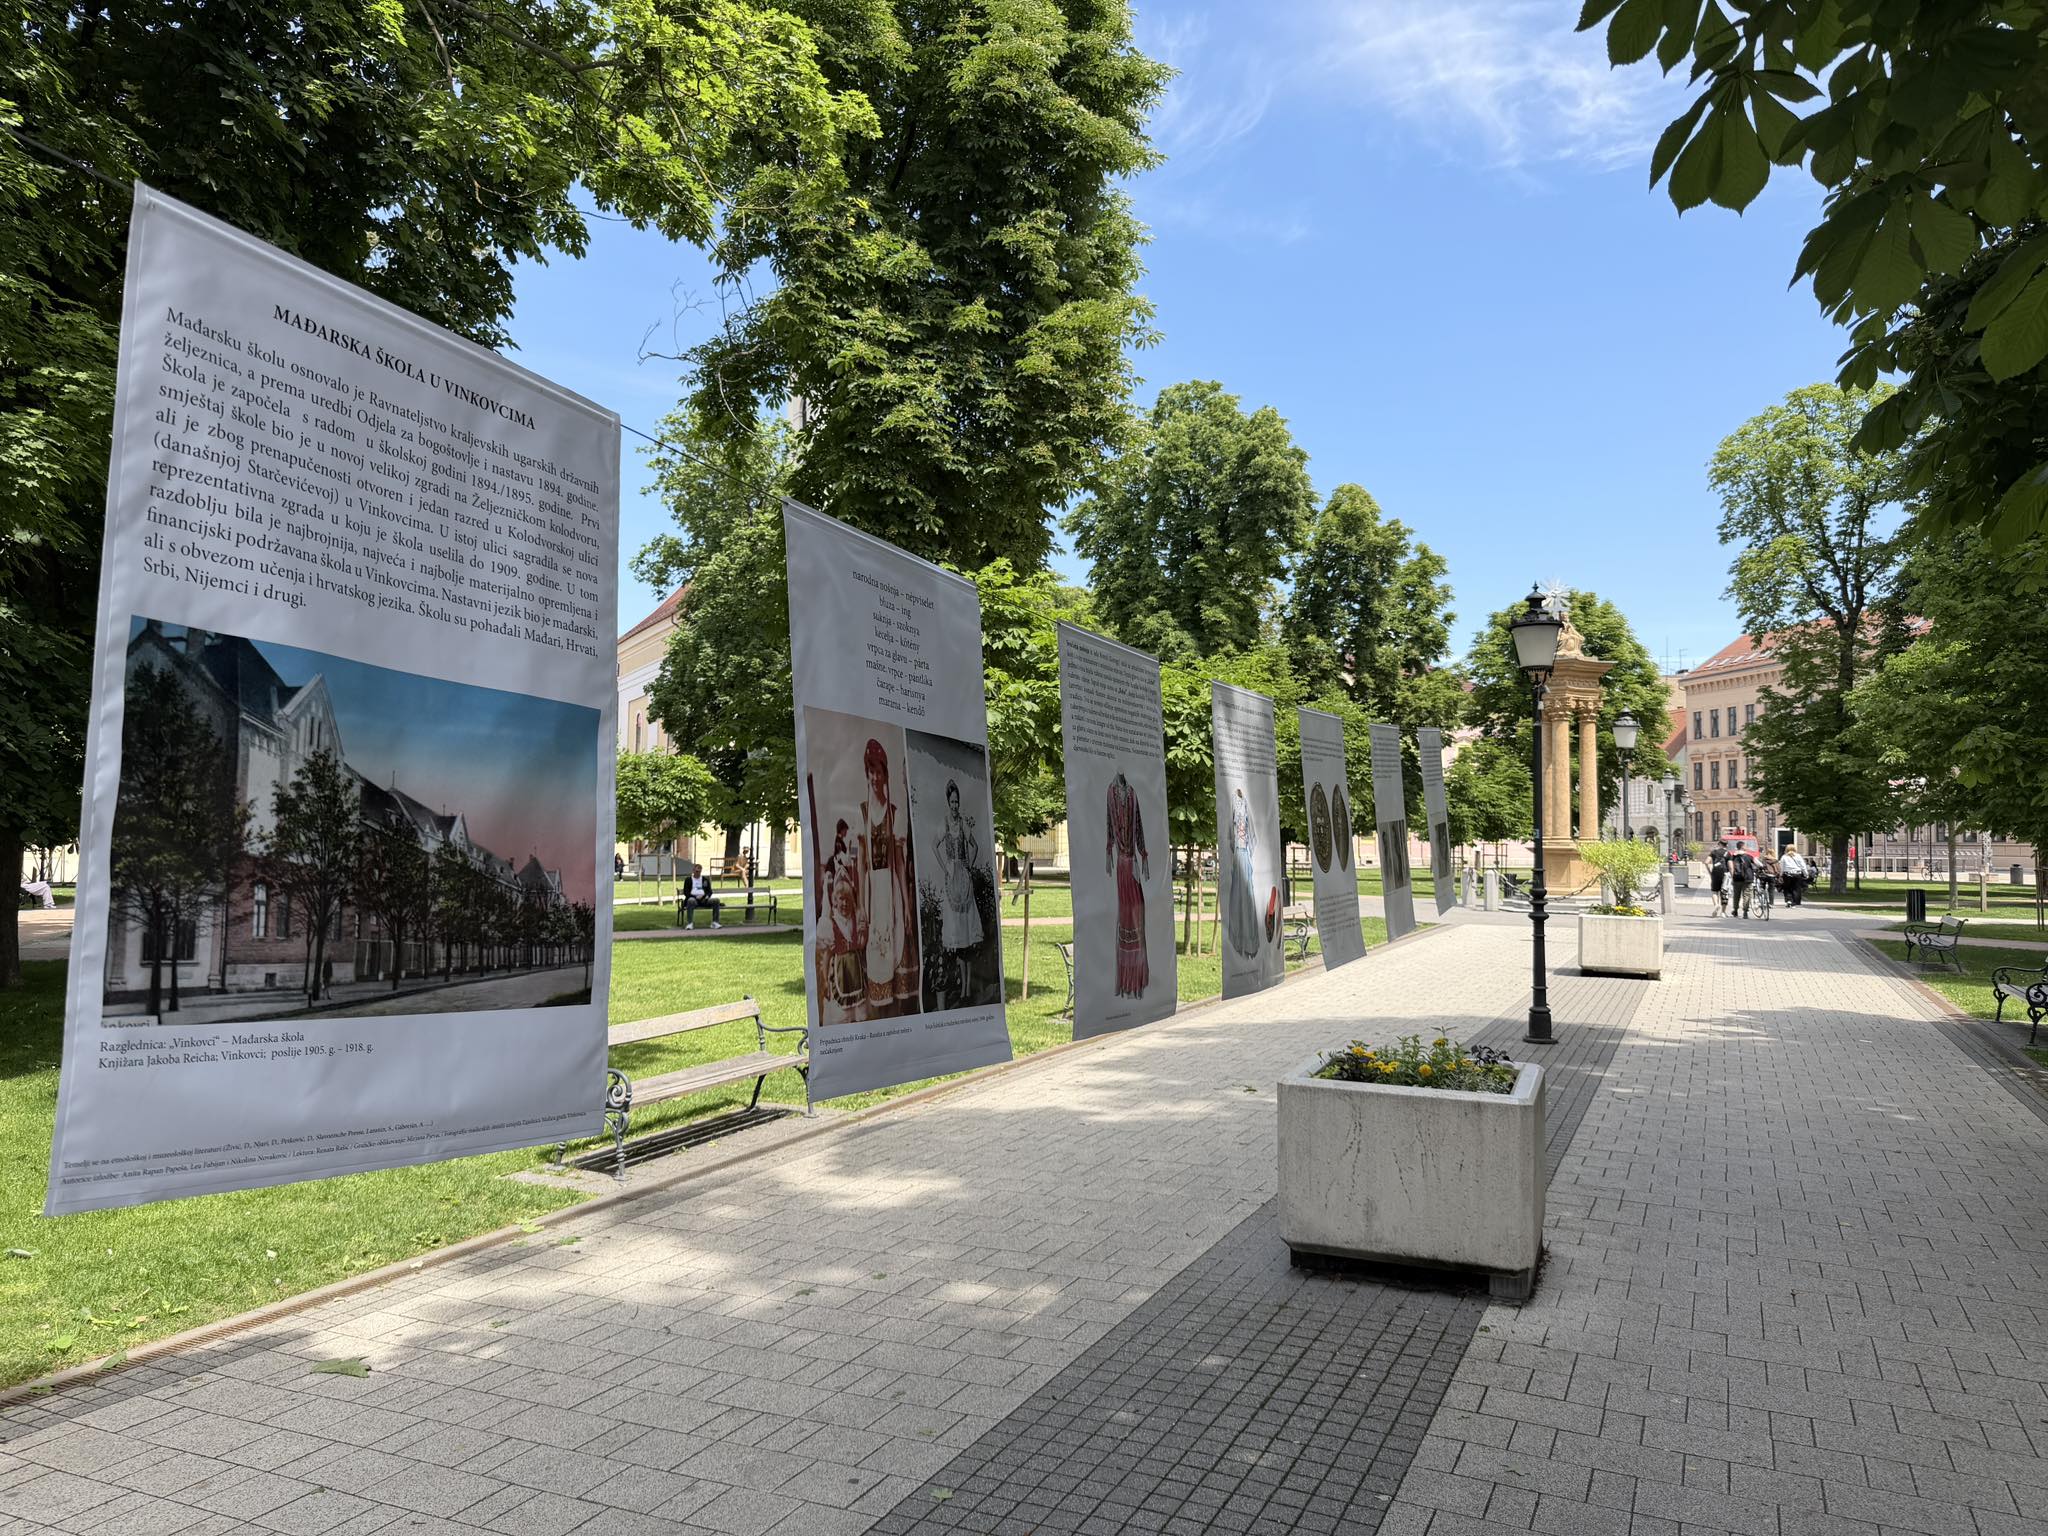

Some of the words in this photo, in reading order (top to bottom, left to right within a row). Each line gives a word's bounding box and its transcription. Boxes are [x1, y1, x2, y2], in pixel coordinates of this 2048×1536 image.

[163, 330, 242, 377] željeznica,
[247, 369, 256, 381] a
[260, 373, 306, 400] prema
[310, 392, 352, 419] uredbi
[356, 407, 397, 436] Odjela
[400, 428, 414, 443] za
[417, 430, 481, 470] bogoštovlje
[483, 457, 488, 472] i
[491, 463, 534, 487] nastavu
[538, 477, 564, 498] 1894.
[565, 491, 599, 513] godine.
[165, 306, 242, 352] Mađarsku
[246, 340, 285, 369] školu
[290, 362, 350, 395] osnovalo
[351, 384, 365, 402] je
[368, 391, 447, 434] Ravnateljstvo
[450, 423, 509, 459] kraljevskih
[512, 451, 557, 477] ugarskih
[559, 467, 599, 495] državnih
[272, 304, 372, 361] MAĐARSKA
[373, 345, 429, 384] ŠKOLA
[429, 372, 441, 389] U
[443, 378, 536, 431] VINKOVCIMA
[153, 430, 241, 474] (današnjoj
[247, 458, 339, 505] Starčevićevoj)
[344, 496, 353, 508] u
[358, 496, 434, 534] Vinkovcima.
[439, 523, 450, 538] U
[453, 528, 478, 552] istoj
[482, 538, 508, 557] ulici
[512, 549, 559, 572] sagradila
[561, 565, 575, 576] se
[575, 566, 598, 585] nova
[155, 406, 177, 427] ali
[182, 414, 200, 435] je
[207, 422, 245, 451] zbog
[250, 439, 352, 486] prenapučenosti
[355, 477, 403, 503] otvoren
[408, 492, 414, 506] i
[416, 491, 449, 519] jedan
[454, 511, 489, 532] razred
[494, 524, 503, 536] u
[504, 524, 575, 562] Kolodvorskoj
[578, 549, 599, 567] ulici
[158, 385, 225, 420] smještaj
[230, 404, 267, 432] škole
[271, 419, 294, 441] bio
[298, 431, 312, 449] je
[316, 440, 326, 453] u
[330, 446, 365, 472] novoj
[369, 460, 410, 488] velikoj
[414, 476, 450, 498] zgradi
[454, 490, 468, 505] na
[471, 491, 546, 529] Željezničkom
[549, 518, 600, 550] kolodvoru,
[161, 352, 207, 385] Škola
[211, 374, 226, 393] je
[230, 385, 291, 418] započela
[301, 413, 309, 424] s
[314, 417, 356, 443] radom
[365, 437, 374, 449] u
[378, 438, 428, 472] školskoj
[430, 461, 467, 484] godini
[471, 473, 535, 506] 1894./1895.
[536, 499, 574, 521] godine.
[580, 512, 600, 531] Prvi
[143, 556, 180, 582] Srbi,
[184, 565, 249, 595] Nijemci
[252, 581, 259, 597] i
[262, 583, 307, 610] drugi.
[143, 531, 164, 551] ali
[167, 541, 176, 554] s
[180, 540, 255, 572] obvezom
[259, 560, 306, 586] učenja
[308, 571, 313, 586] i
[315, 572, 376, 608] hrvatskog
[376, 591, 415, 615] jezika.
[418, 599, 452, 624] Školu
[453, 615, 468, 627] su
[469, 617, 521, 639] pohađali
[523, 626, 564, 650] Mađari,
[565, 637, 598, 659] Hrvati,
[146, 505, 232, 542] financijski
[233, 531, 318, 565] podržavana
[320, 551, 352, 575] škola
[354, 566, 363, 578] u
[364, 564, 439, 599] Vinkovcima.
[441, 586, 492, 613] Nastavni
[492, 600, 523, 619] jezik
[523, 606, 541, 626] bio
[540, 612, 551, 629] je
[552, 613, 599, 641] mađarski,
[148, 482, 228, 517] razdoblju
[234, 501, 264, 525] bila
[267, 512, 282, 532] je
[286, 521, 358, 556] najbrojnija,
[362, 546, 406, 569] najveća
[410, 557, 415, 572] i
[419, 563, 465, 587] najbolje
[468, 577, 535, 602] materijalno
[537, 595, 593, 619] opremljena
[594, 608, 598, 621] i
[151, 456, 276, 505] reprezentativna
[280, 497, 325, 521] zgrada
[330, 513, 339, 526] u
[344, 513, 371, 538] koju
[375, 525, 388, 543] je
[392, 530, 424, 552] škola
[429, 544, 465, 565] uselila
[469, 553, 485, 570] do
[490, 559, 521, 583] 1909.
[523, 572, 563, 592] godine.
[566, 581, 576, 598] U
[579, 587, 599, 603] tom
[98, 1055, 144, 1070] Knjižara
[146, 1053, 180, 1067] Jakoba
[183, 1051, 219, 1064] Reicha;
[221, 1048, 266, 1062] Vinkovci;
[271, 1042, 302, 1060] poslije
[304, 1043, 326, 1056] 1905.
[100, 1040, 167, 1056] Razglednica:
[231, 1033, 279, 1047] Mađarska
[281, 1031, 304, 1043] škola
